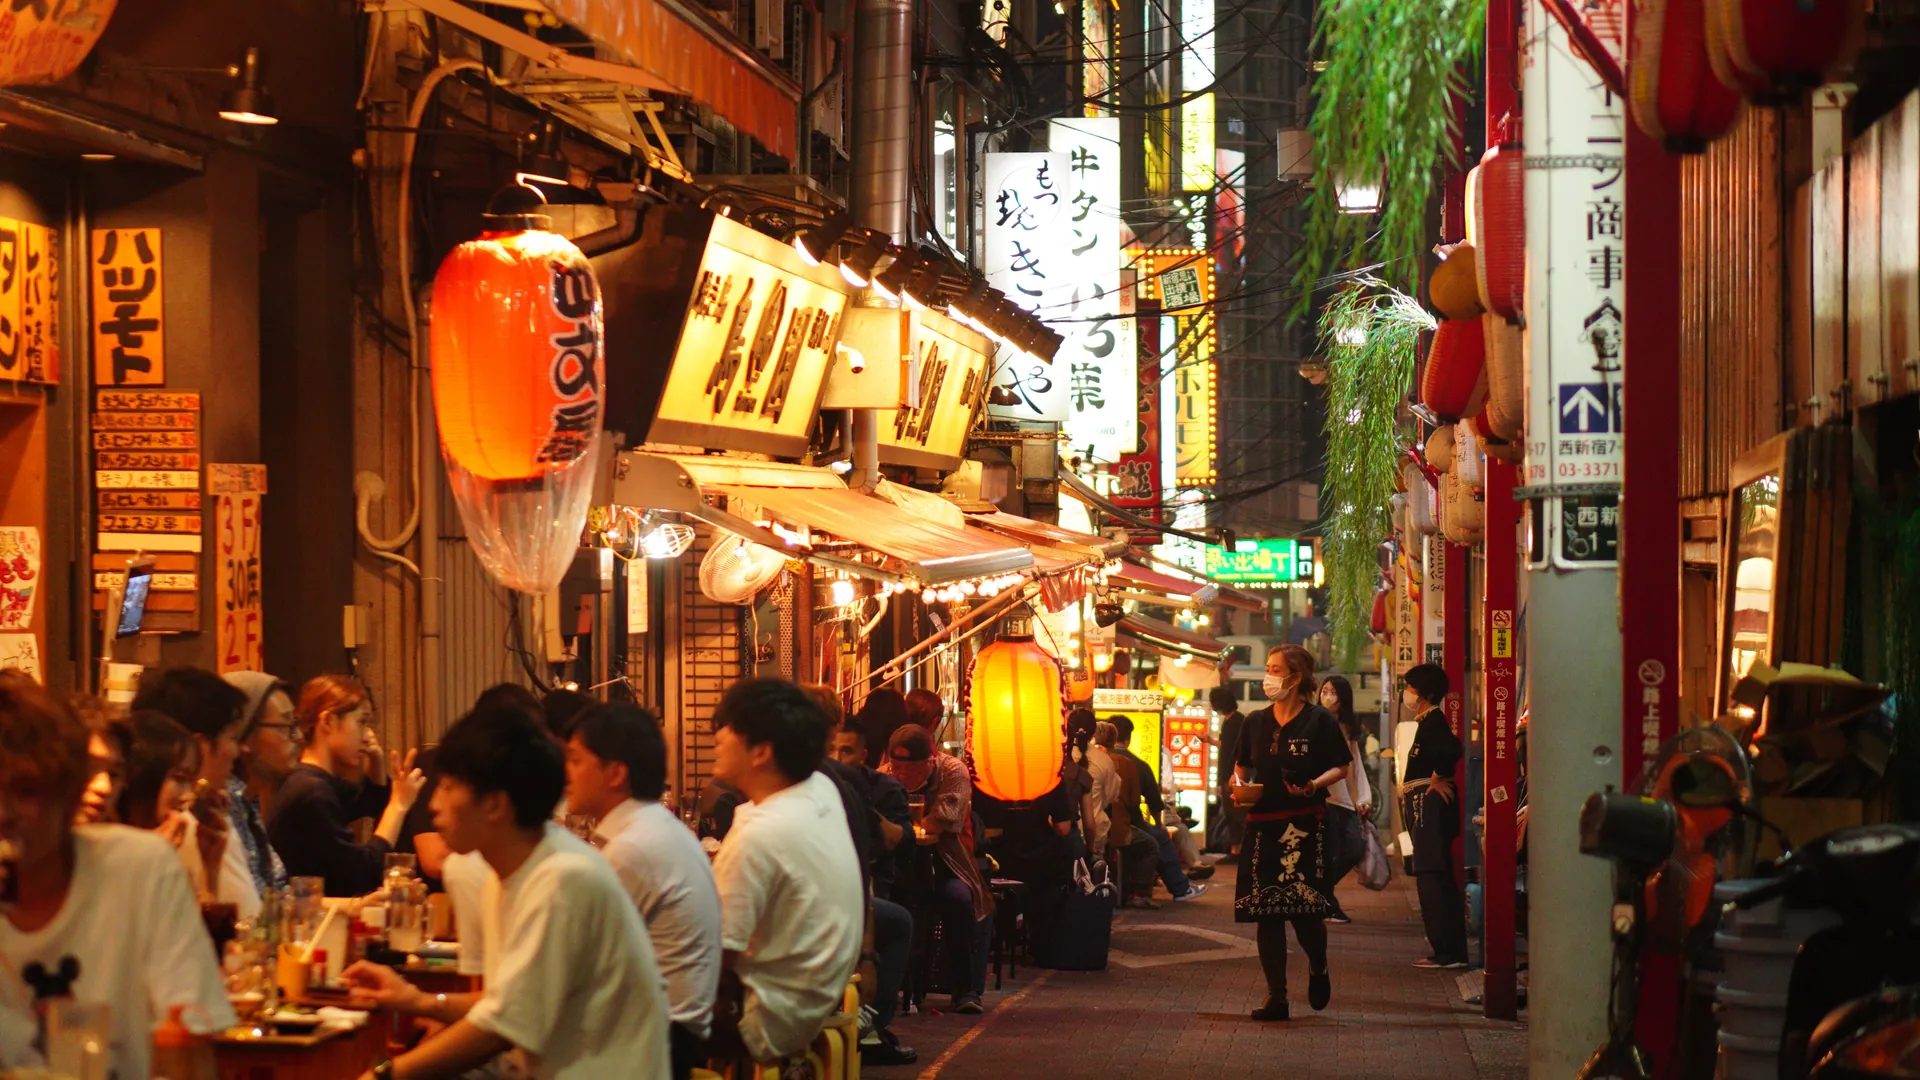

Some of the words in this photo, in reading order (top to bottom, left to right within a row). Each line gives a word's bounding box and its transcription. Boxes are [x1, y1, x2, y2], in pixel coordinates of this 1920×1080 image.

[1033, 159, 1059, 205] もつ
[1071, 145, 1100, 256] 牛タン
[1071, 283, 1115, 412] いろ葉
[1559, 462, 1618, 477] 03-3371
